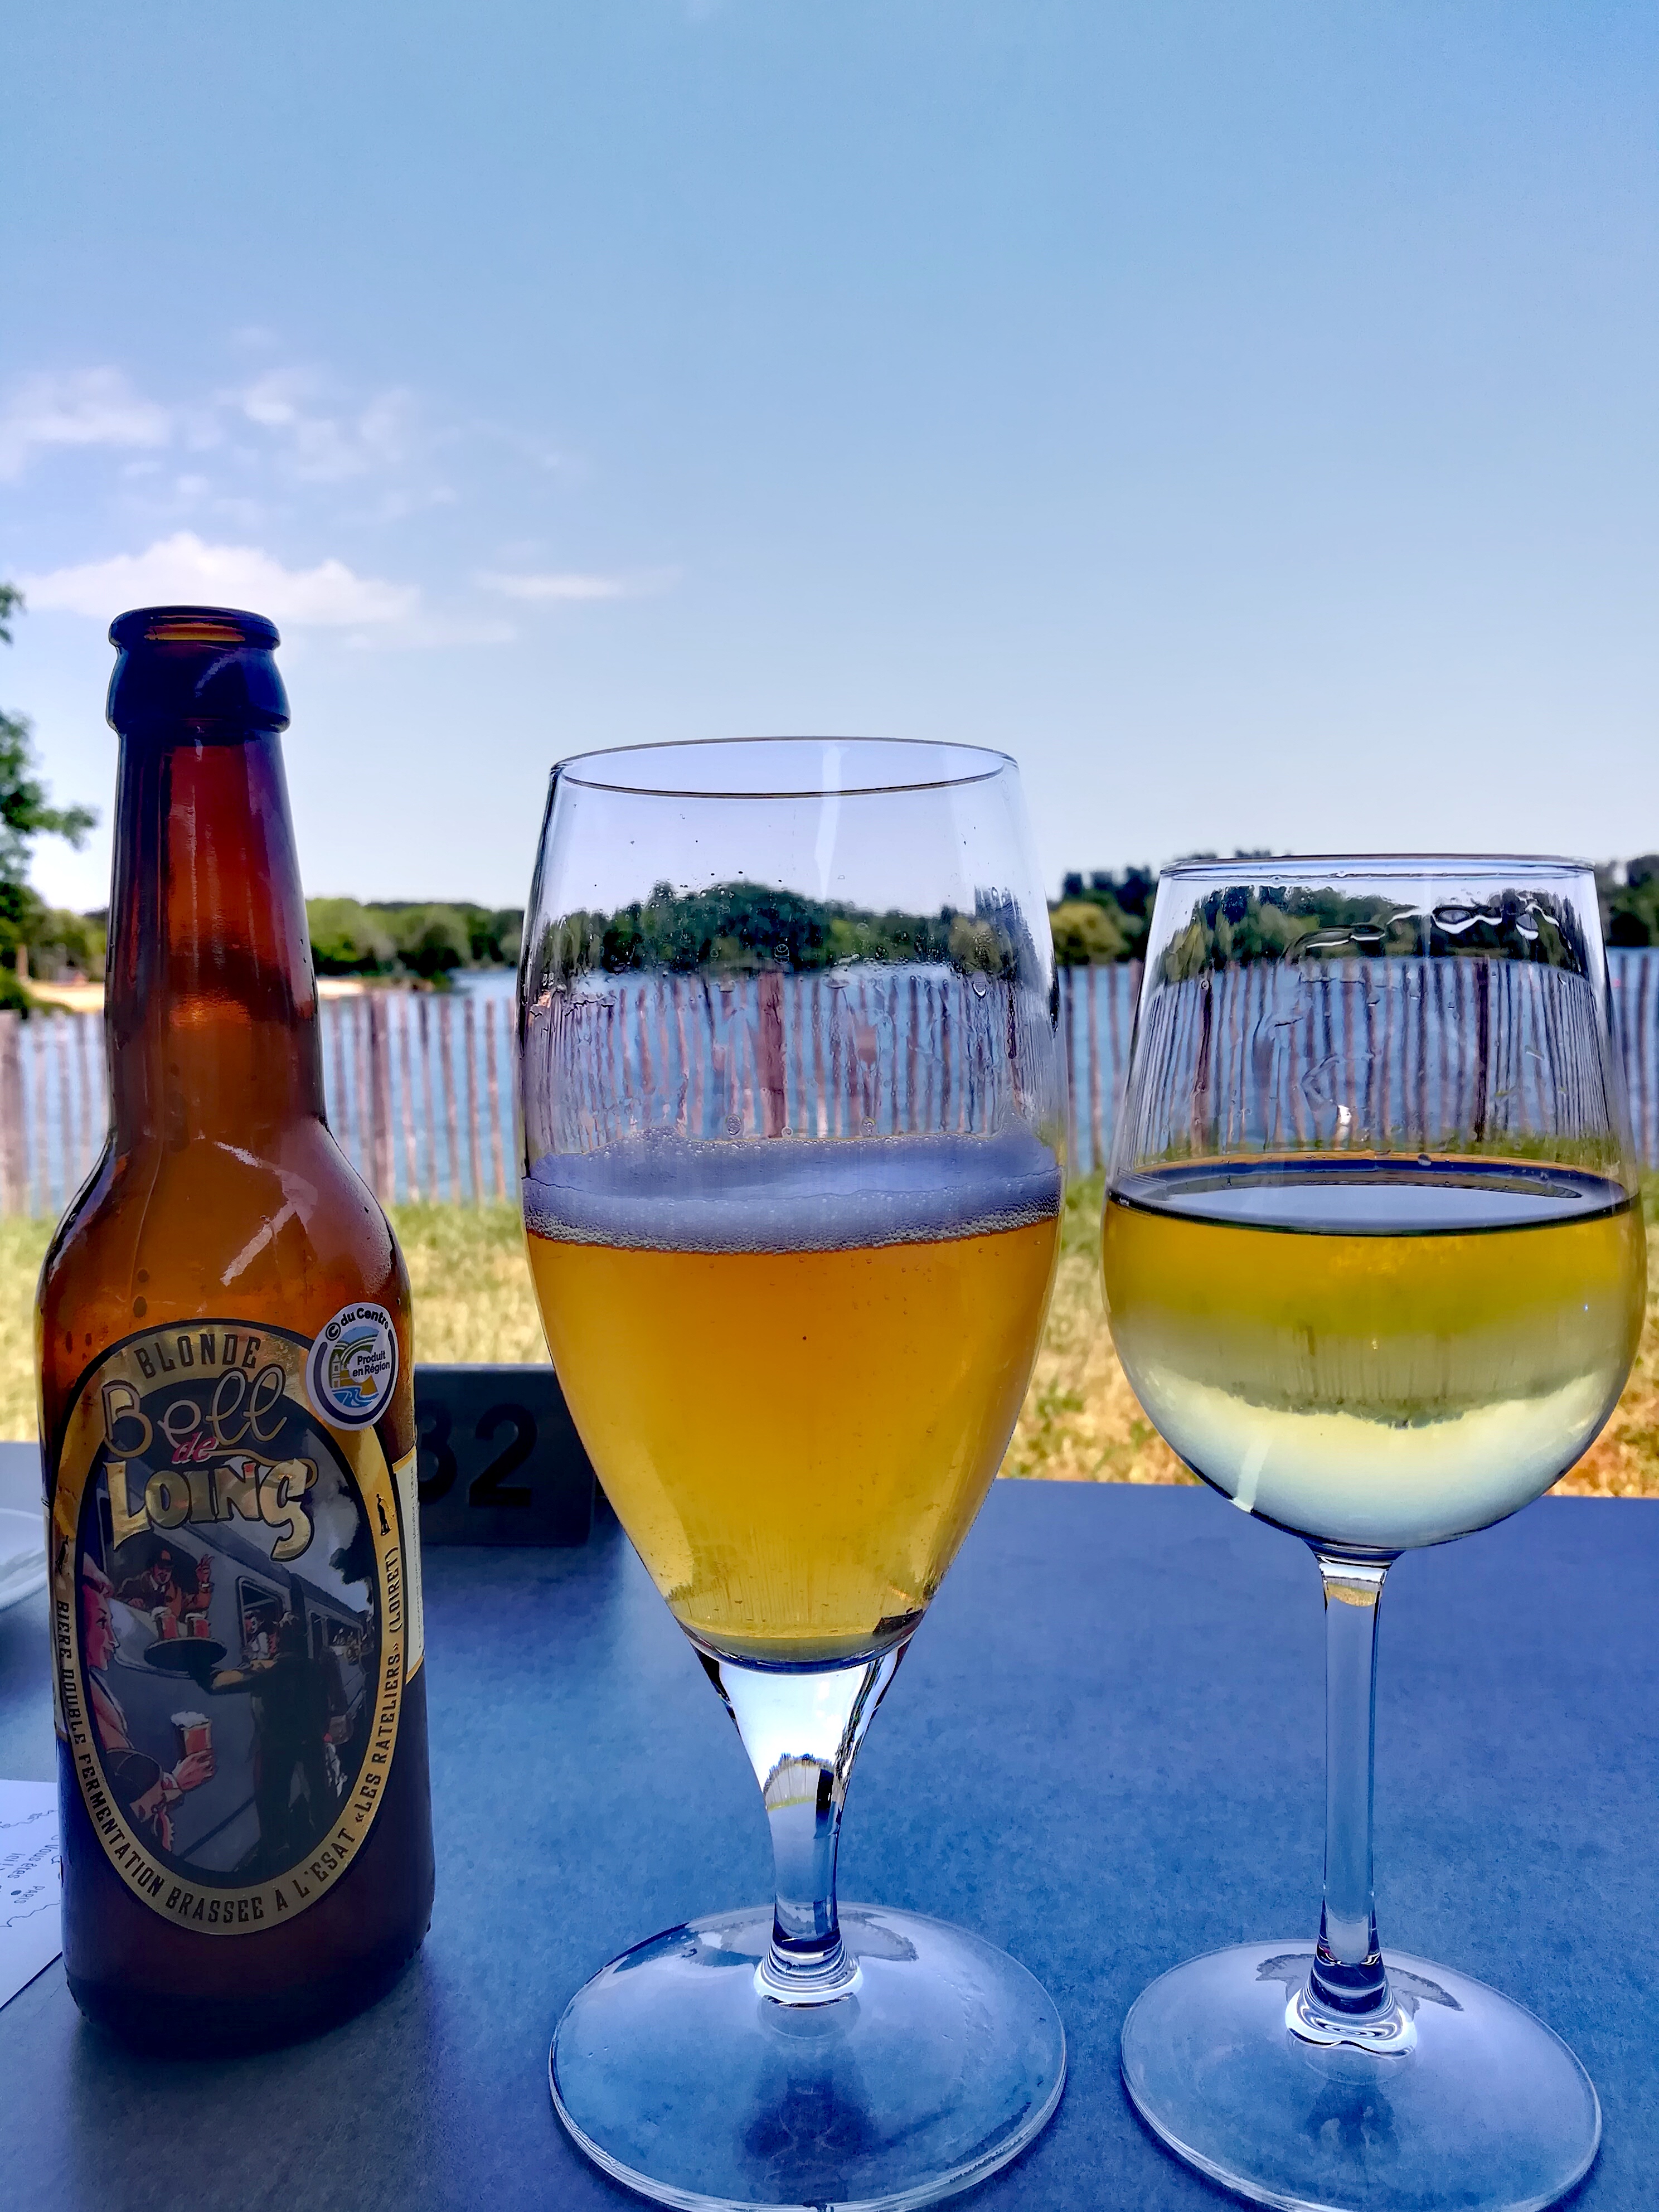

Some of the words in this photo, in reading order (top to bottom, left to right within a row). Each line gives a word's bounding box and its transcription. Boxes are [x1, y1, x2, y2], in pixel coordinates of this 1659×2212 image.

[341, 1312, 356, 1326] du
[357, 1308, 389, 1330] Centre
[134, 1333, 261, 1380] BLONDE
[357, 1350, 386, 1365] Produit
[352, 1367, 364, 1377] en
[365, 1361, 390, 1375] Région
[172, 1433, 217, 1464] de
[62, 1668, 86, 1745] DOUBLE
[78, 1753, 166, 1897] FERMENTATION
[291, 1827, 356, 1899] L'ESAT
[385, 1547, 403, 1633] (LOIRET)
[28, 1845, 59, 1862] Vous
[13, 1886, 46, 1904] PARIS
